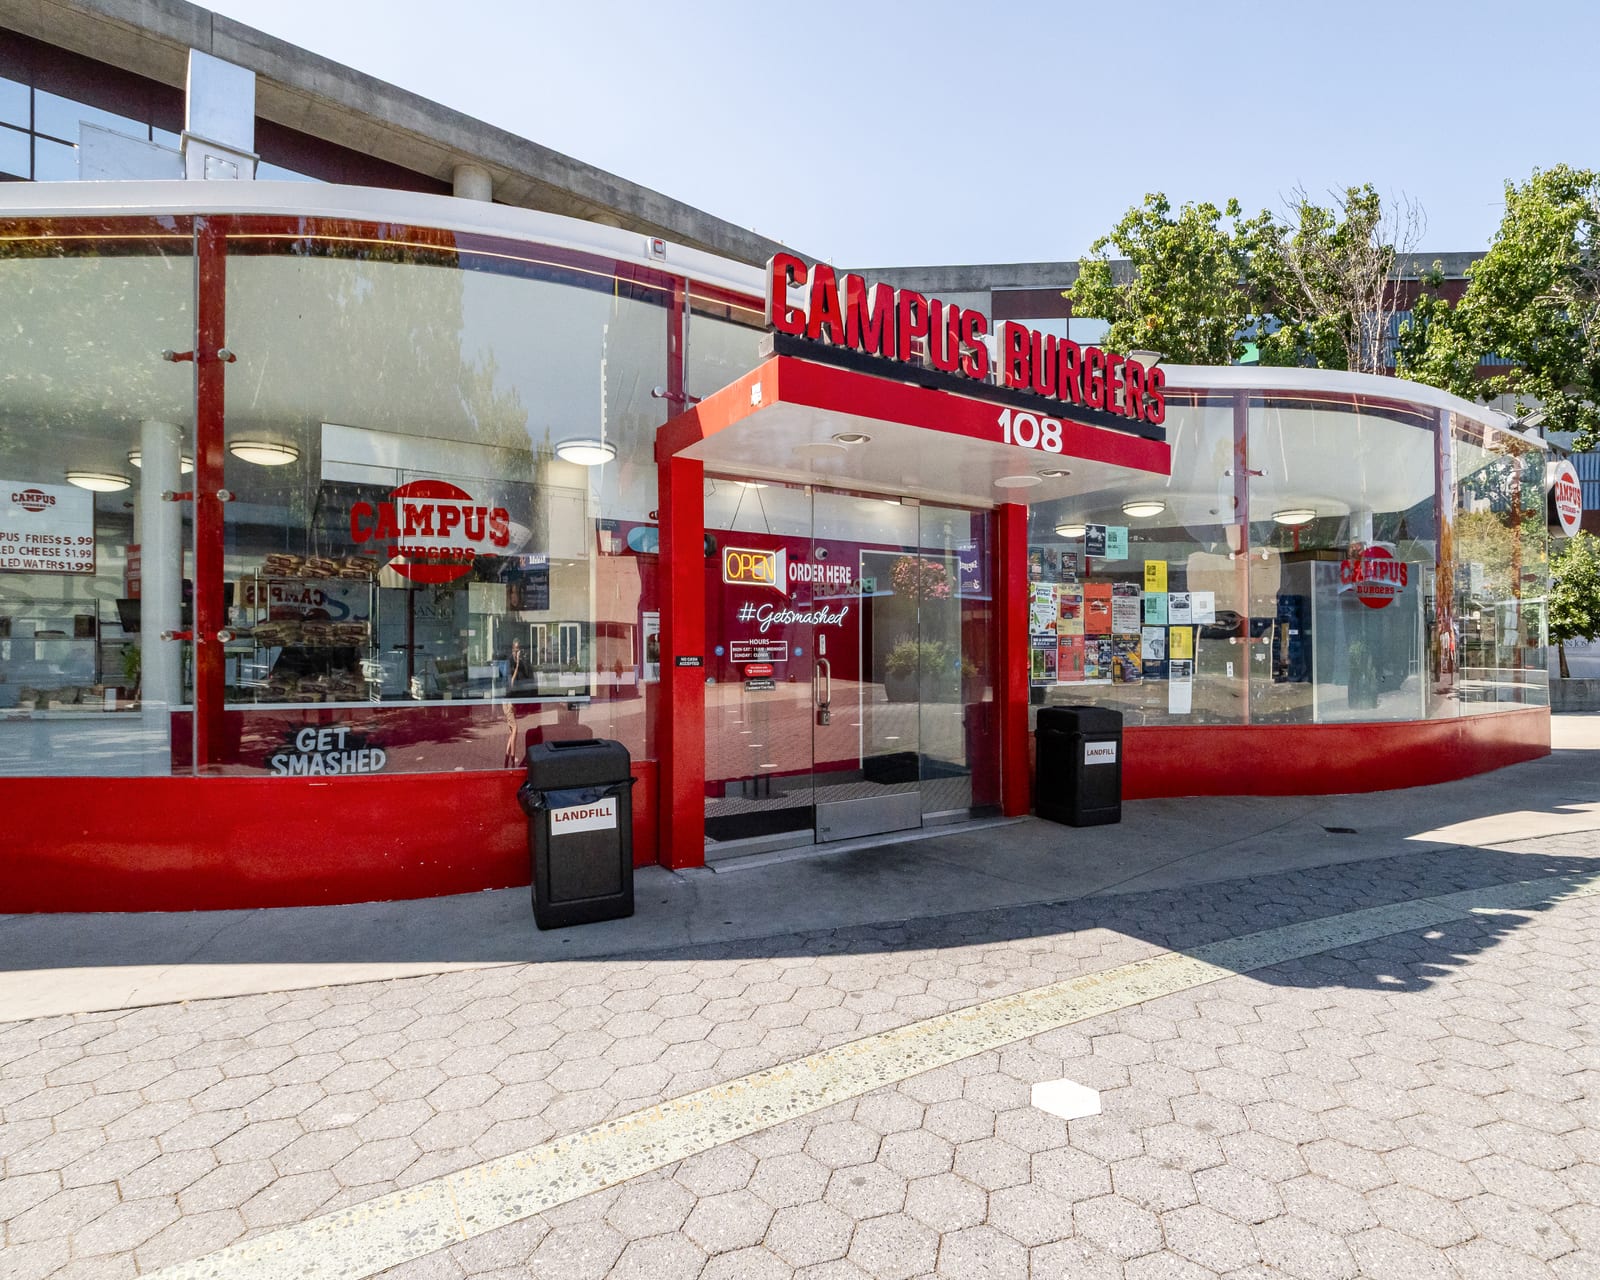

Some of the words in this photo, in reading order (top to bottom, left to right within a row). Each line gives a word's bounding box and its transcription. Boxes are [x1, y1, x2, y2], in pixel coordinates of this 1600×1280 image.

[766, 252, 988, 380] CAMPUS
[999, 320, 1166, 425] BURGERS
[998, 408, 1062, 454] 108
[11, 493, 56, 505] CAMPUS
[1555, 481, 1582, 509] CAMPUS
[350, 501, 510, 547] CAMPUS
[19, 546, 61, 557] CHEESE
[65, 548, 92, 558] $1.99
[25, 534, 54, 544] FRIES
[55, 536, 93, 546] $5.99
[387, 545, 476, 560] BURGERS
[23, 559, 58, 570] WATER
[57, 561, 93, 571] $1.99
[727, 552, 774, 580] OPEN
[789, 562, 825, 582] ORDER
[826, 565, 852, 584] HERE
[1340, 560, 1408, 587] CAMPUS
[1356, 585, 1395, 594] BURGERS
[296, 726, 350, 753] GET
[271, 748, 386, 776] SMASHED
[554, 807, 613, 823] LANDFILL
